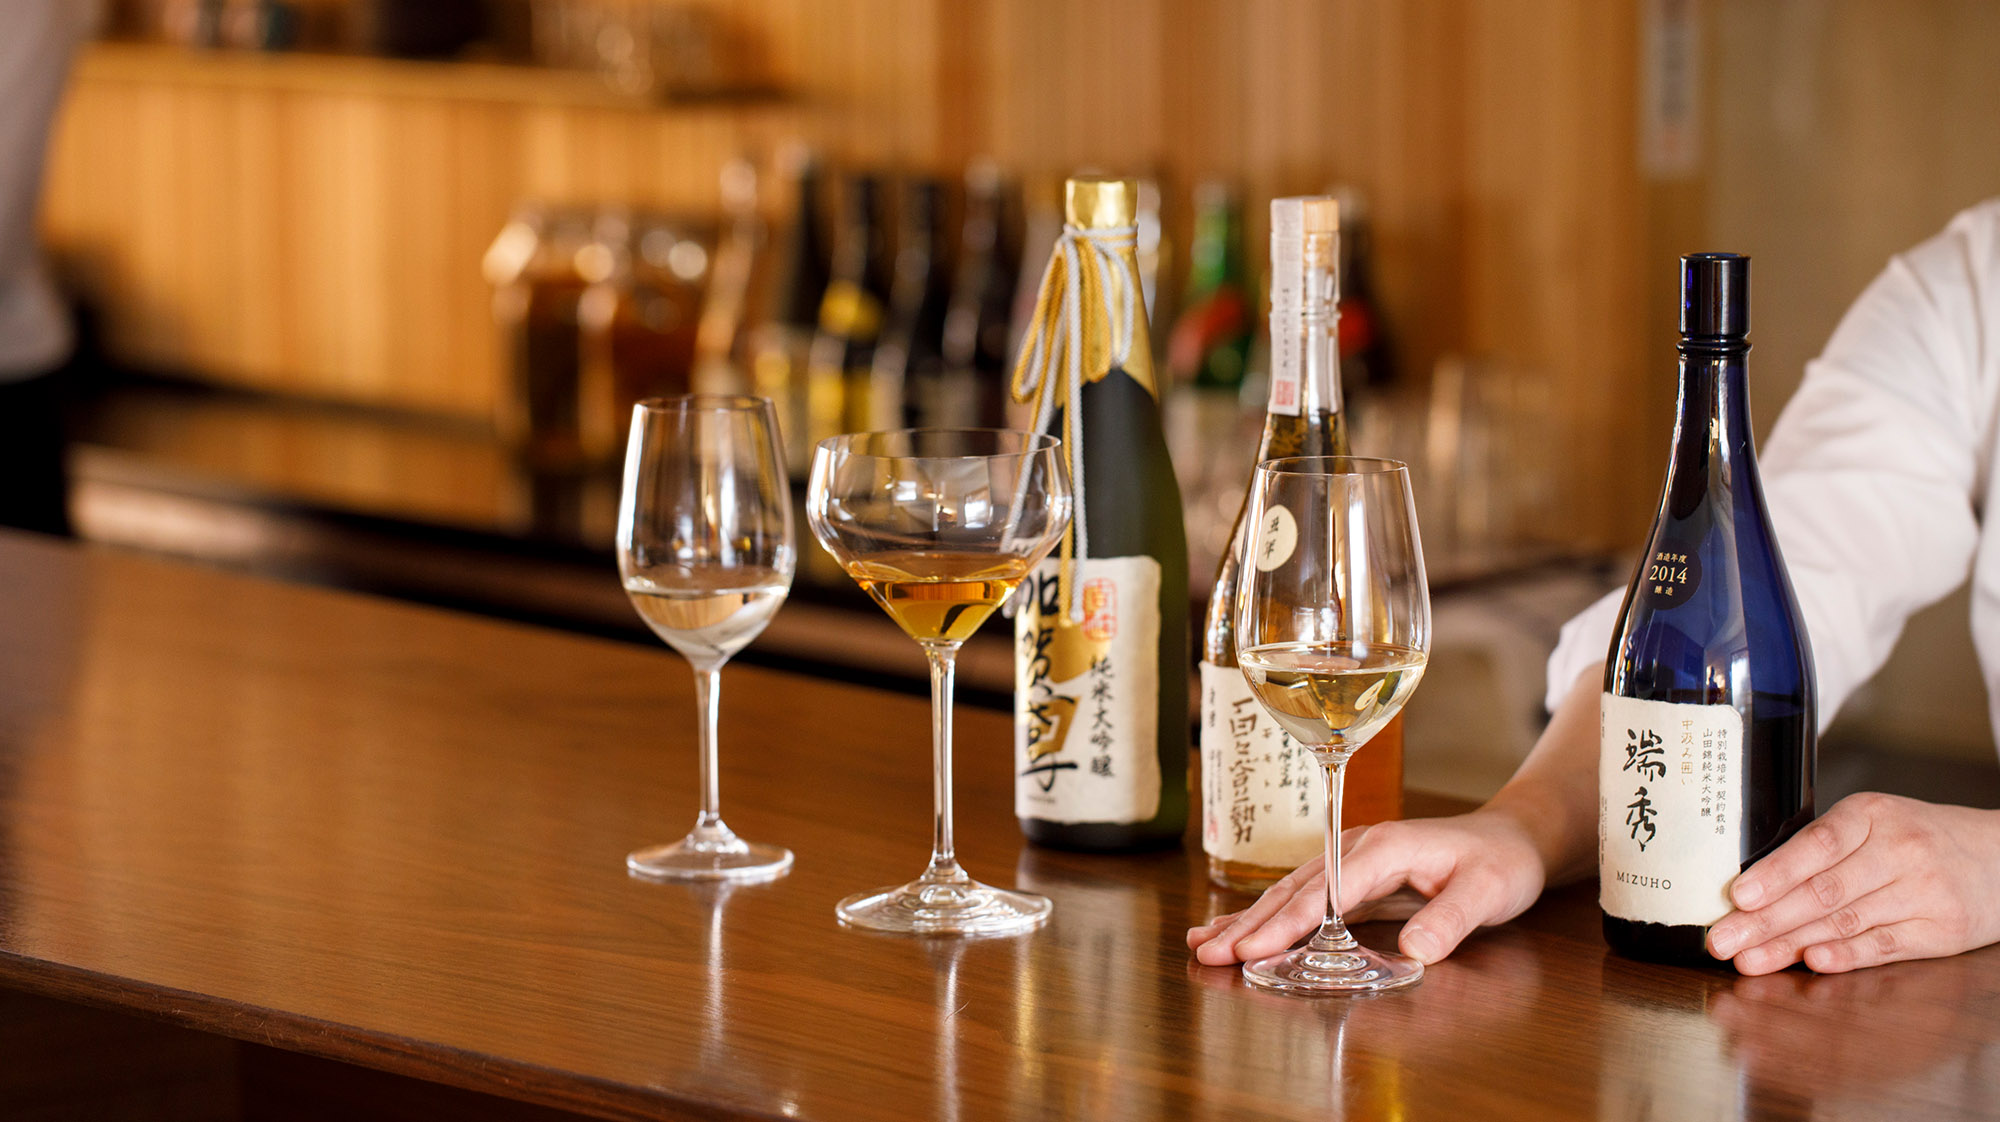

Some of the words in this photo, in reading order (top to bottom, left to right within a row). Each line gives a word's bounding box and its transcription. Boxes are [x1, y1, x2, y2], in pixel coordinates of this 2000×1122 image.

[1649, 565, 1688, 584] 2014
[1656, 552, 1688, 564] 酒造年度
[1090, 655, 1115, 778] 純米大吟醸
[1701, 728, 1713, 817] 山田錦純米大吟醸
[1716, 729, 1727, 784] 特別栽培米
[1623, 728, 1666, 852] 瑞秀
[1715, 790, 1726, 835] 契約栽培
[1616, 870, 1672, 890] MIZUHO
